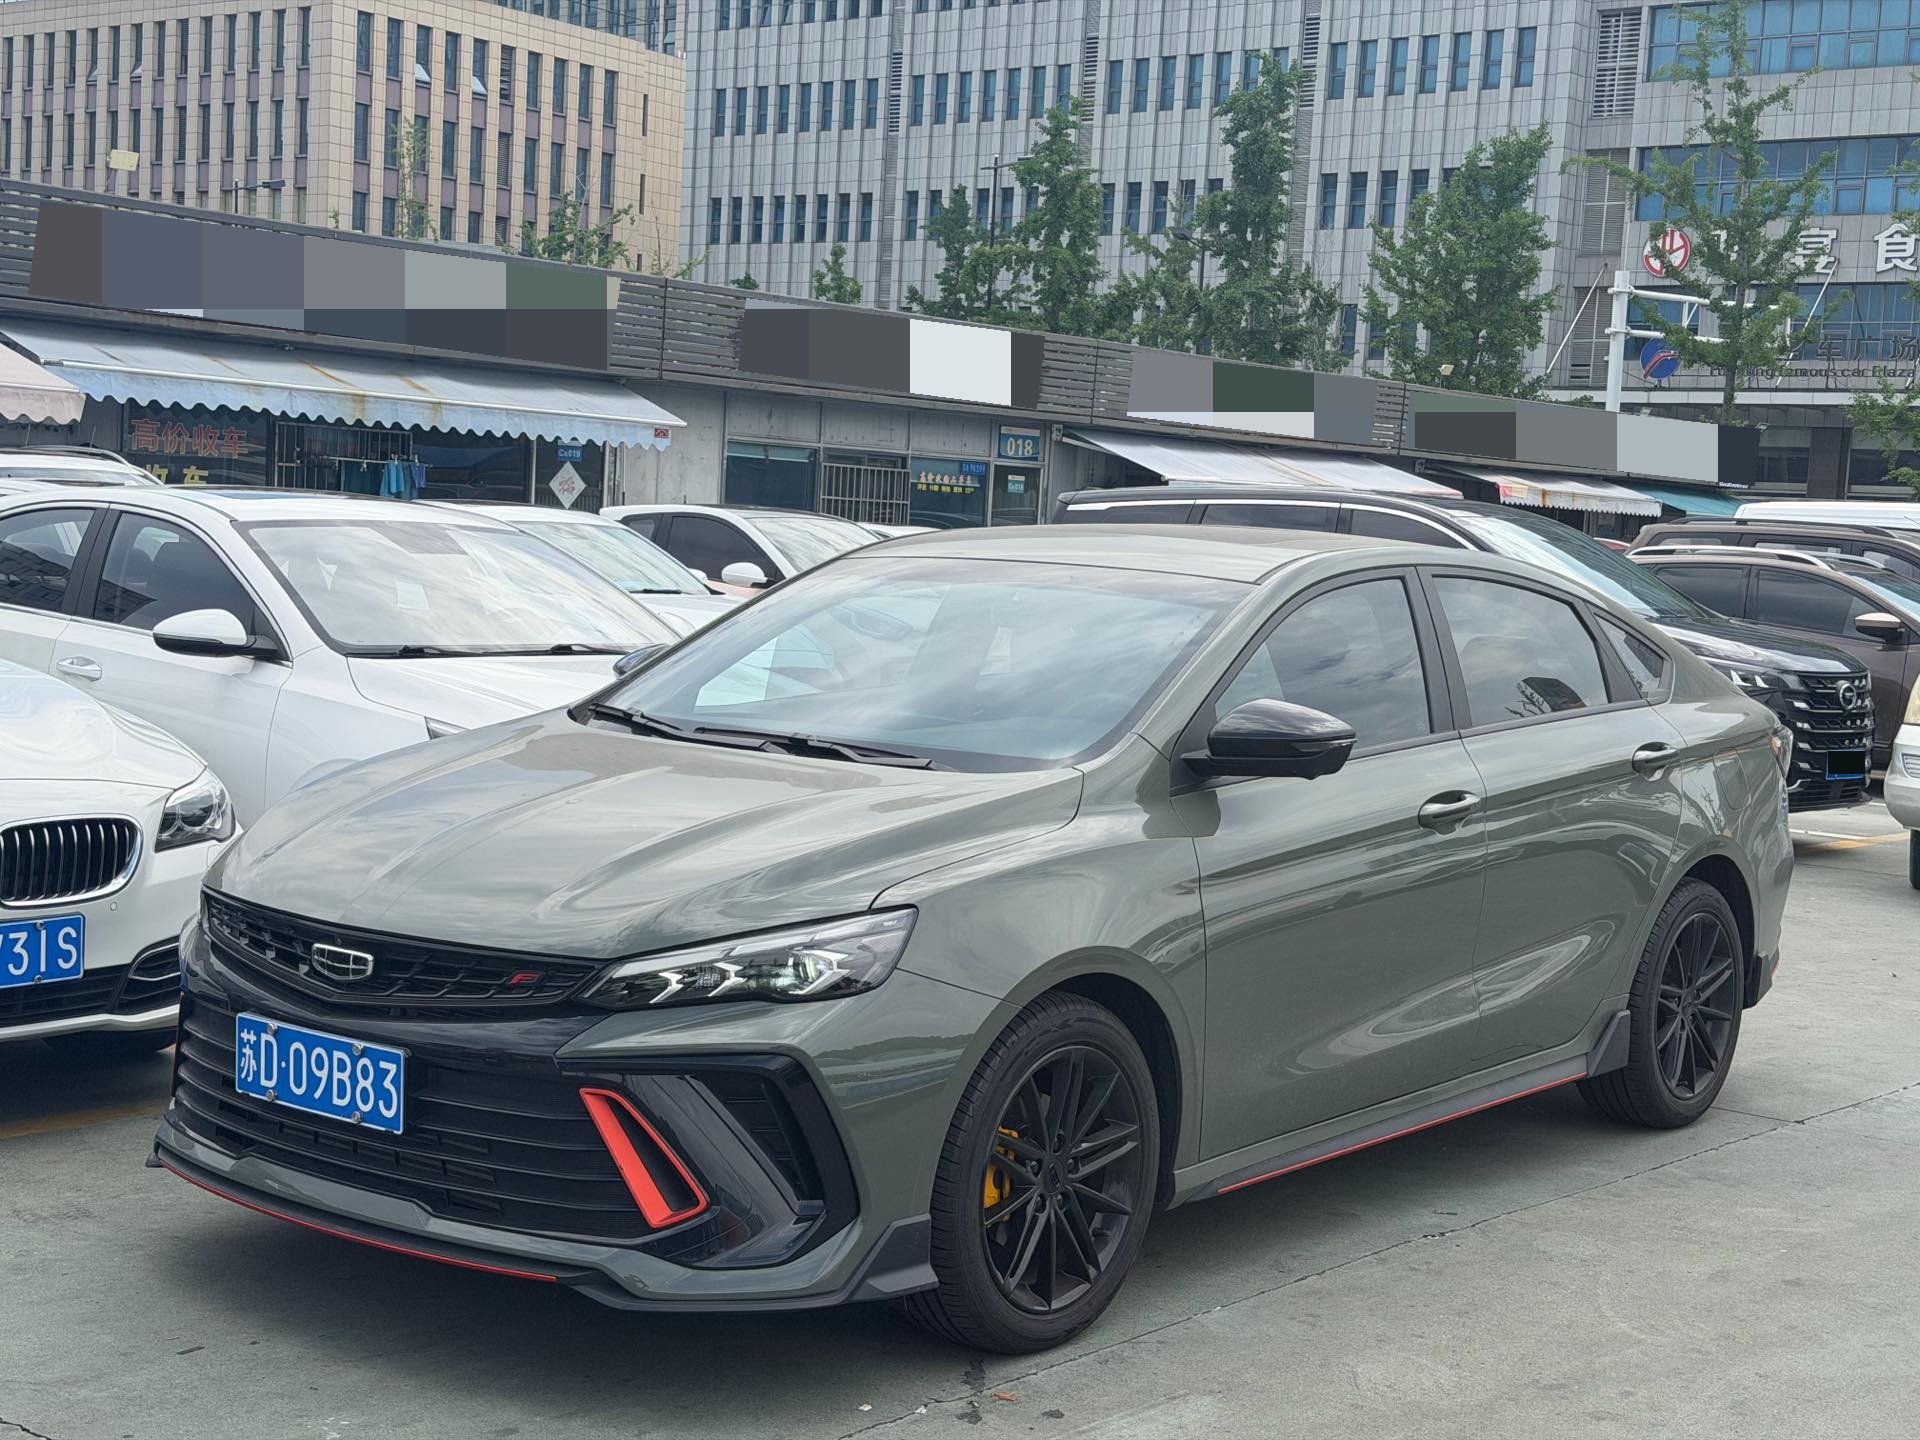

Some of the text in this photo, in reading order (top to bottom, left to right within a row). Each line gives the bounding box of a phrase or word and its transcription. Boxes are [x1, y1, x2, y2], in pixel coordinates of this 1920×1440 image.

[130, 418, 249, 459] 高价收车
[1007, 437, 1033, 456] 018
[0, 926, 77, 977] 31S
